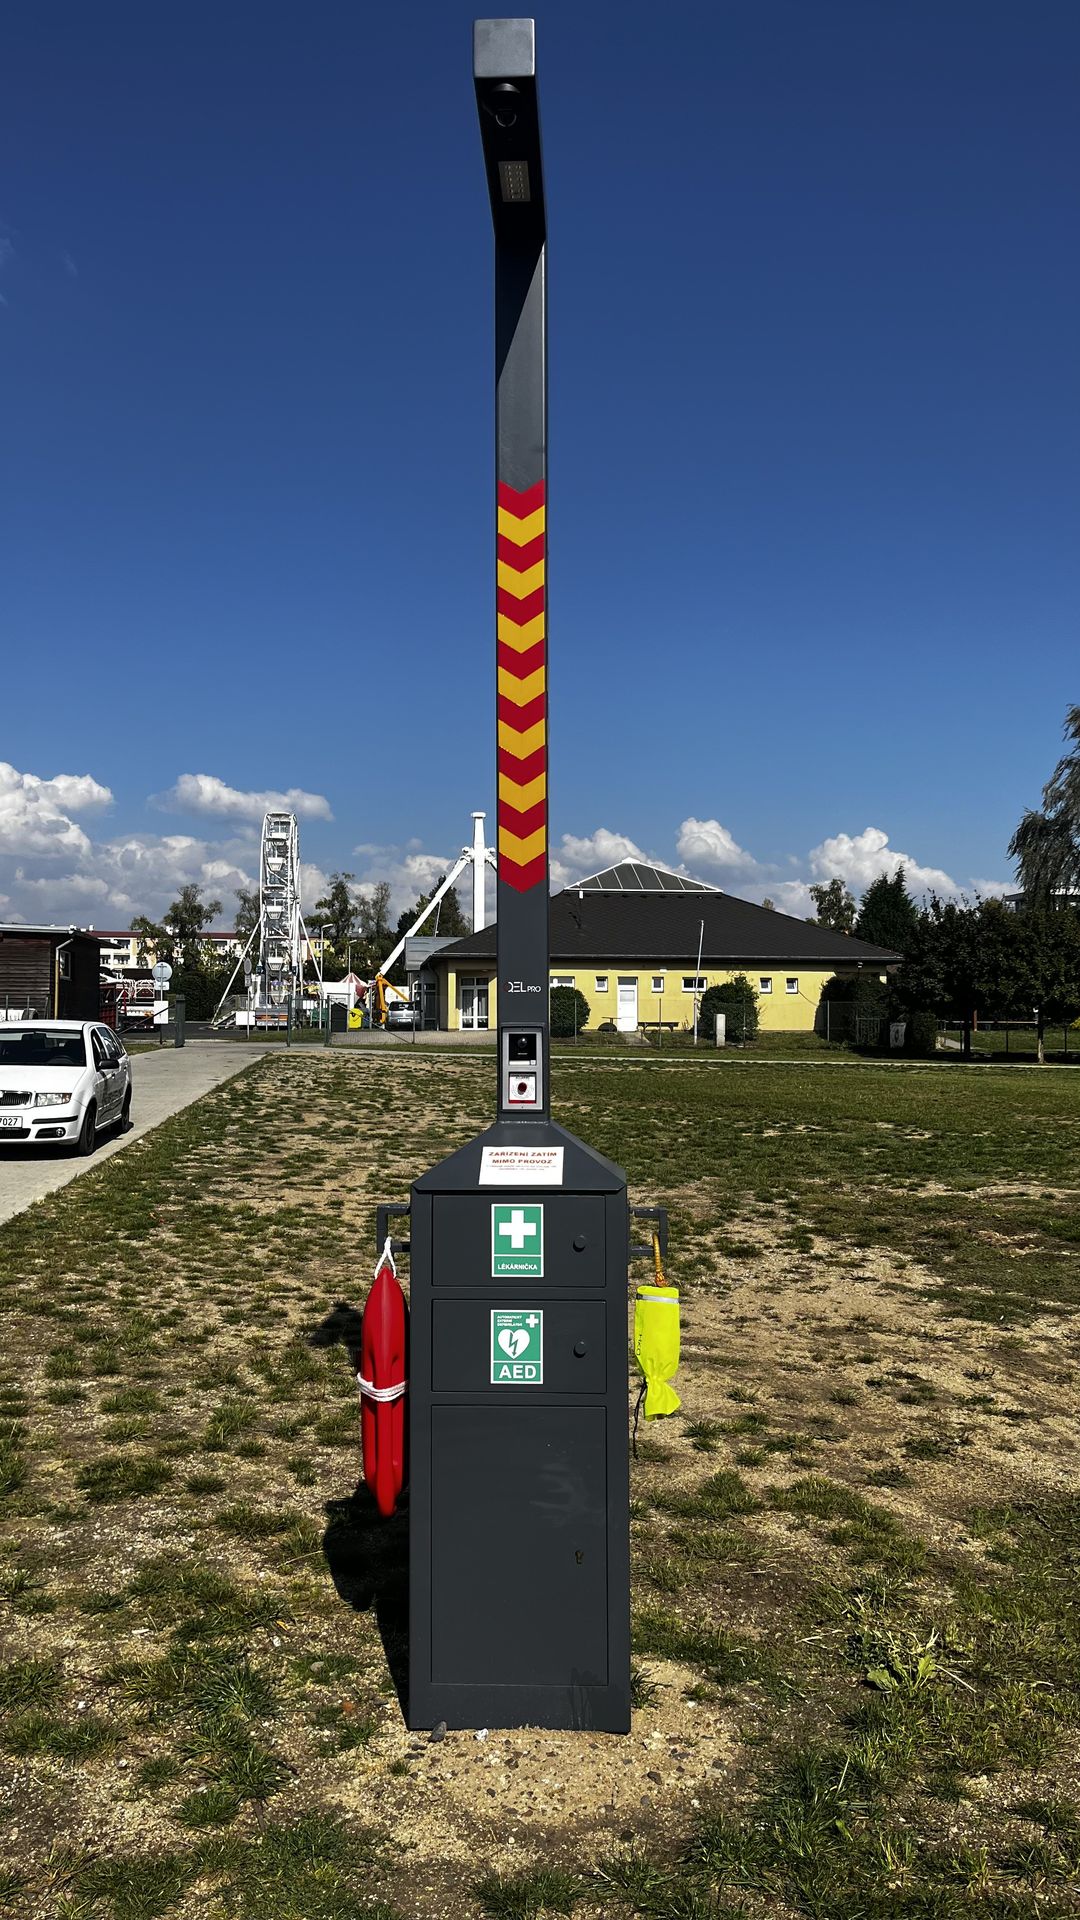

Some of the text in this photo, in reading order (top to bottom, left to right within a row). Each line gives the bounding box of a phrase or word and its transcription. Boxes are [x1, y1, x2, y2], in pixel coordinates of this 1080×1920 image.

[527, 985, 542, 993] PRO
[497, 1262, 538, 1270] LÉKÁRNIČKA
[498, 1364, 537, 1379] AED
